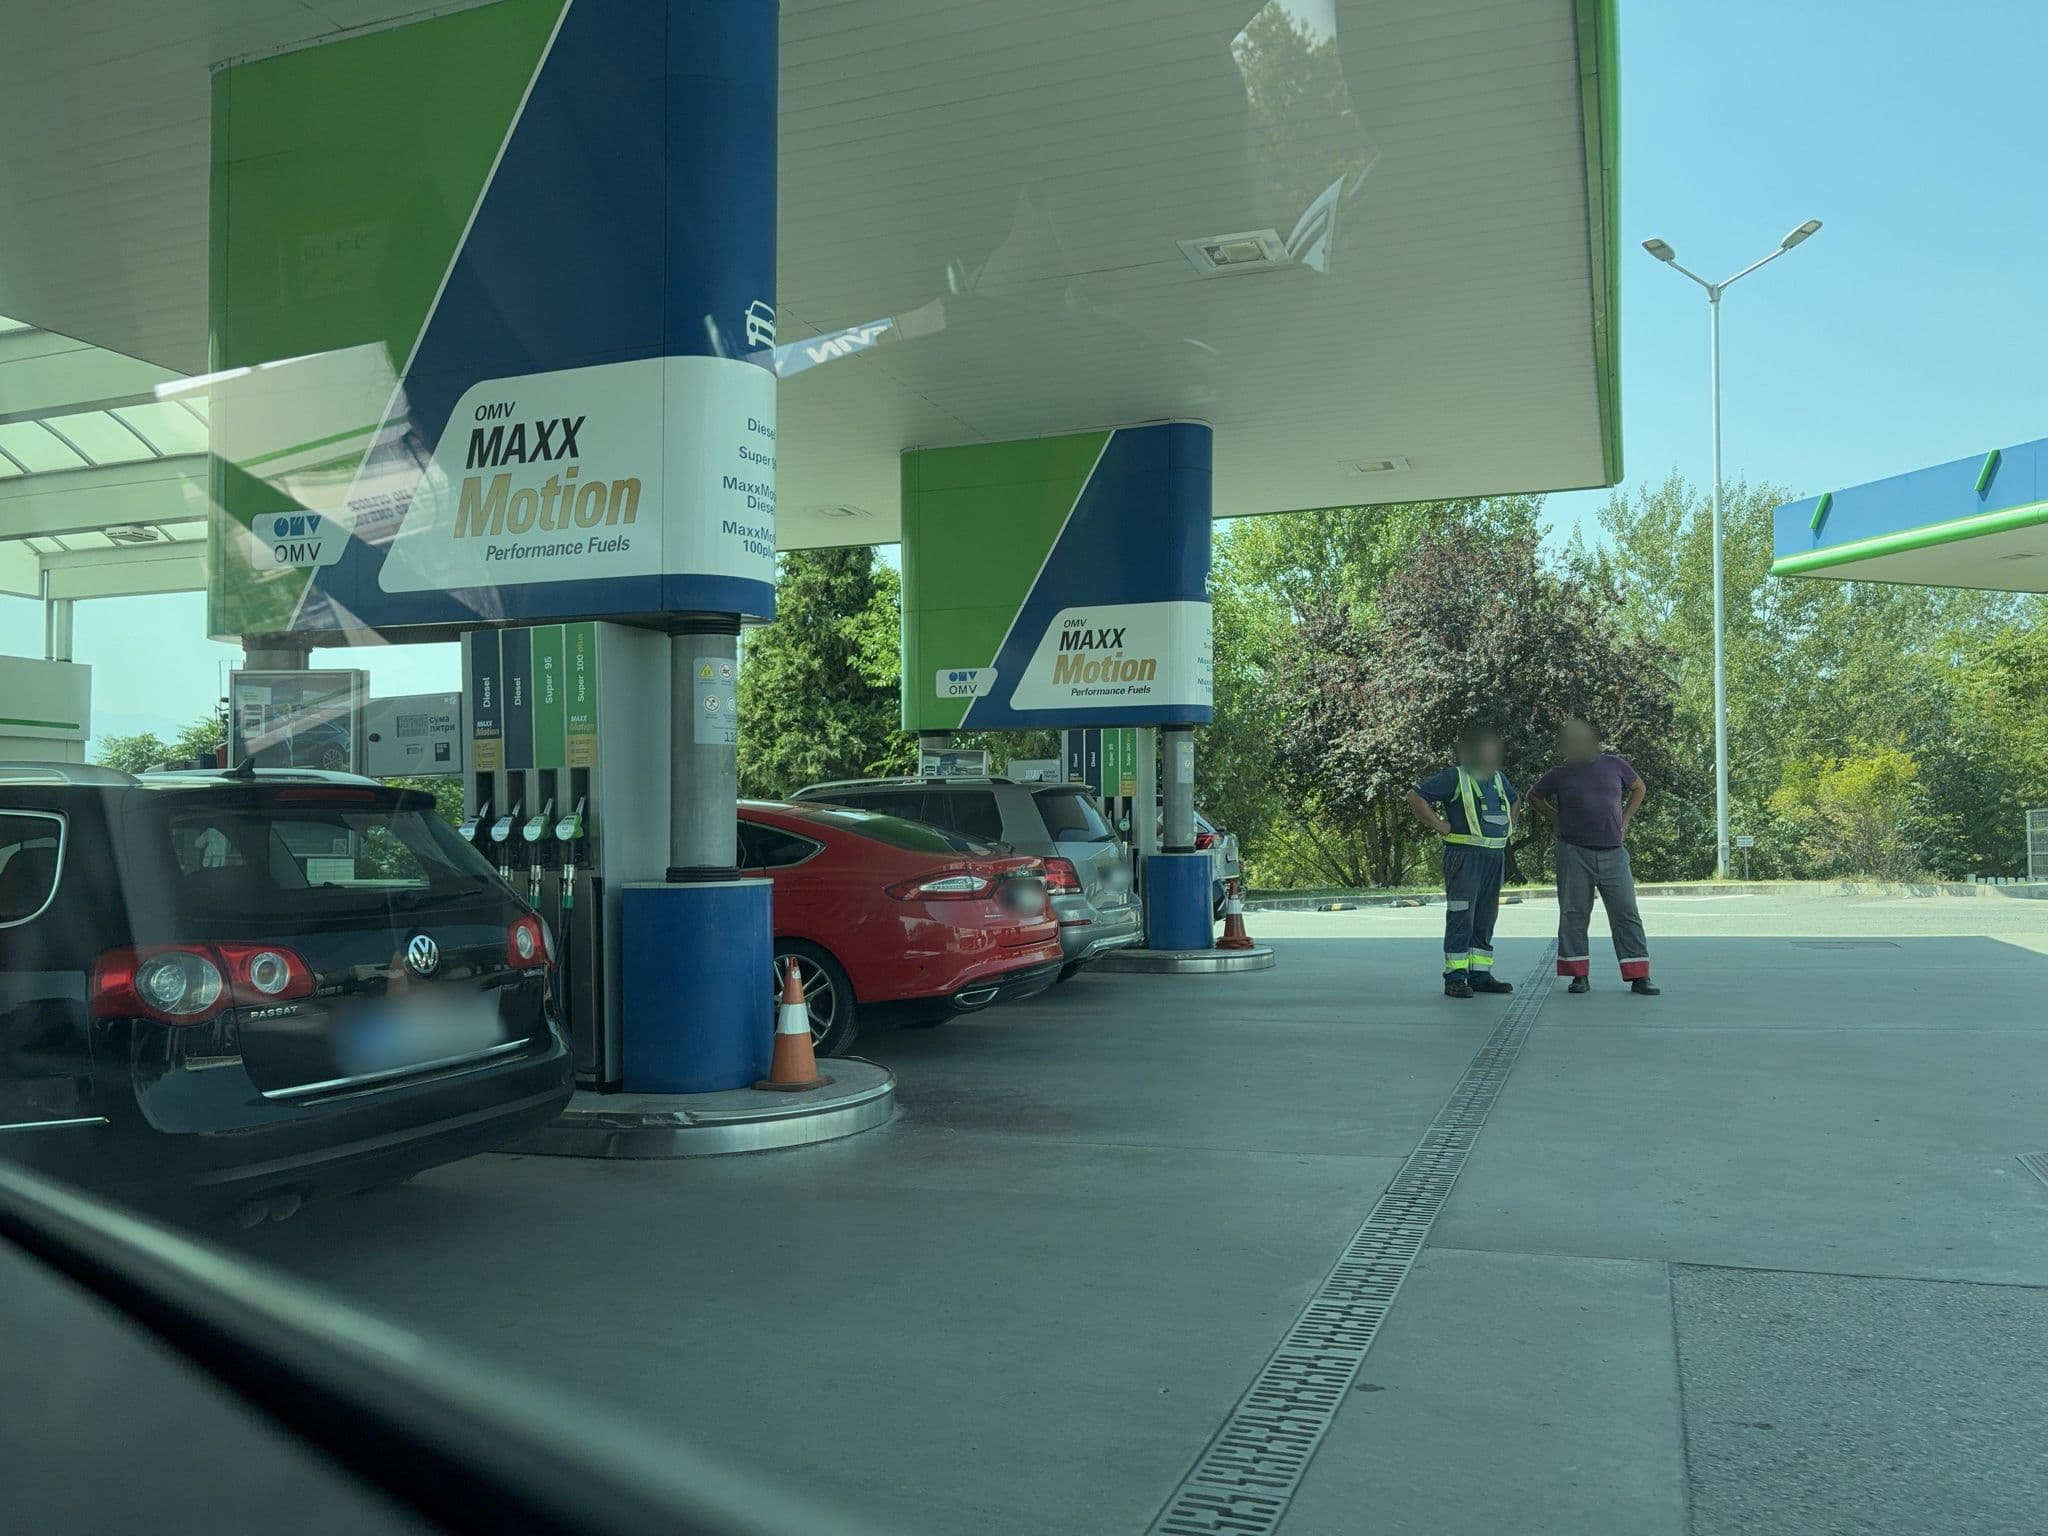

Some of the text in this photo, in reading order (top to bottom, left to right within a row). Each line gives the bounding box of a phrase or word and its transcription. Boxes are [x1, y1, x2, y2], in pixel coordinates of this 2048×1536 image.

[475, 401, 516, 421] OMV
[465, 415, 586, 469] MAXX
[739, 446, 770, 465] Super
[723, 476, 777, 502] MaxxMo
[453, 466, 642, 539] Motion
[722, 520, 777, 544] MaxxMo
[274, 542, 321, 563] OMV
[486, 535, 630, 561] Performance Fuels
[1064, 619, 1087, 628] OMV
[1059, 627, 1126, 651] MAXX
[545, 656, 554, 704] Super 95
[1053, 652, 1157, 684] Motion
[578, 675, 587, 702] Super
[949, 685, 977, 695] OMV
[1071, 685, 1151, 697] Performance Fuels
[250, 1006, 298, 1019] PASSAT
